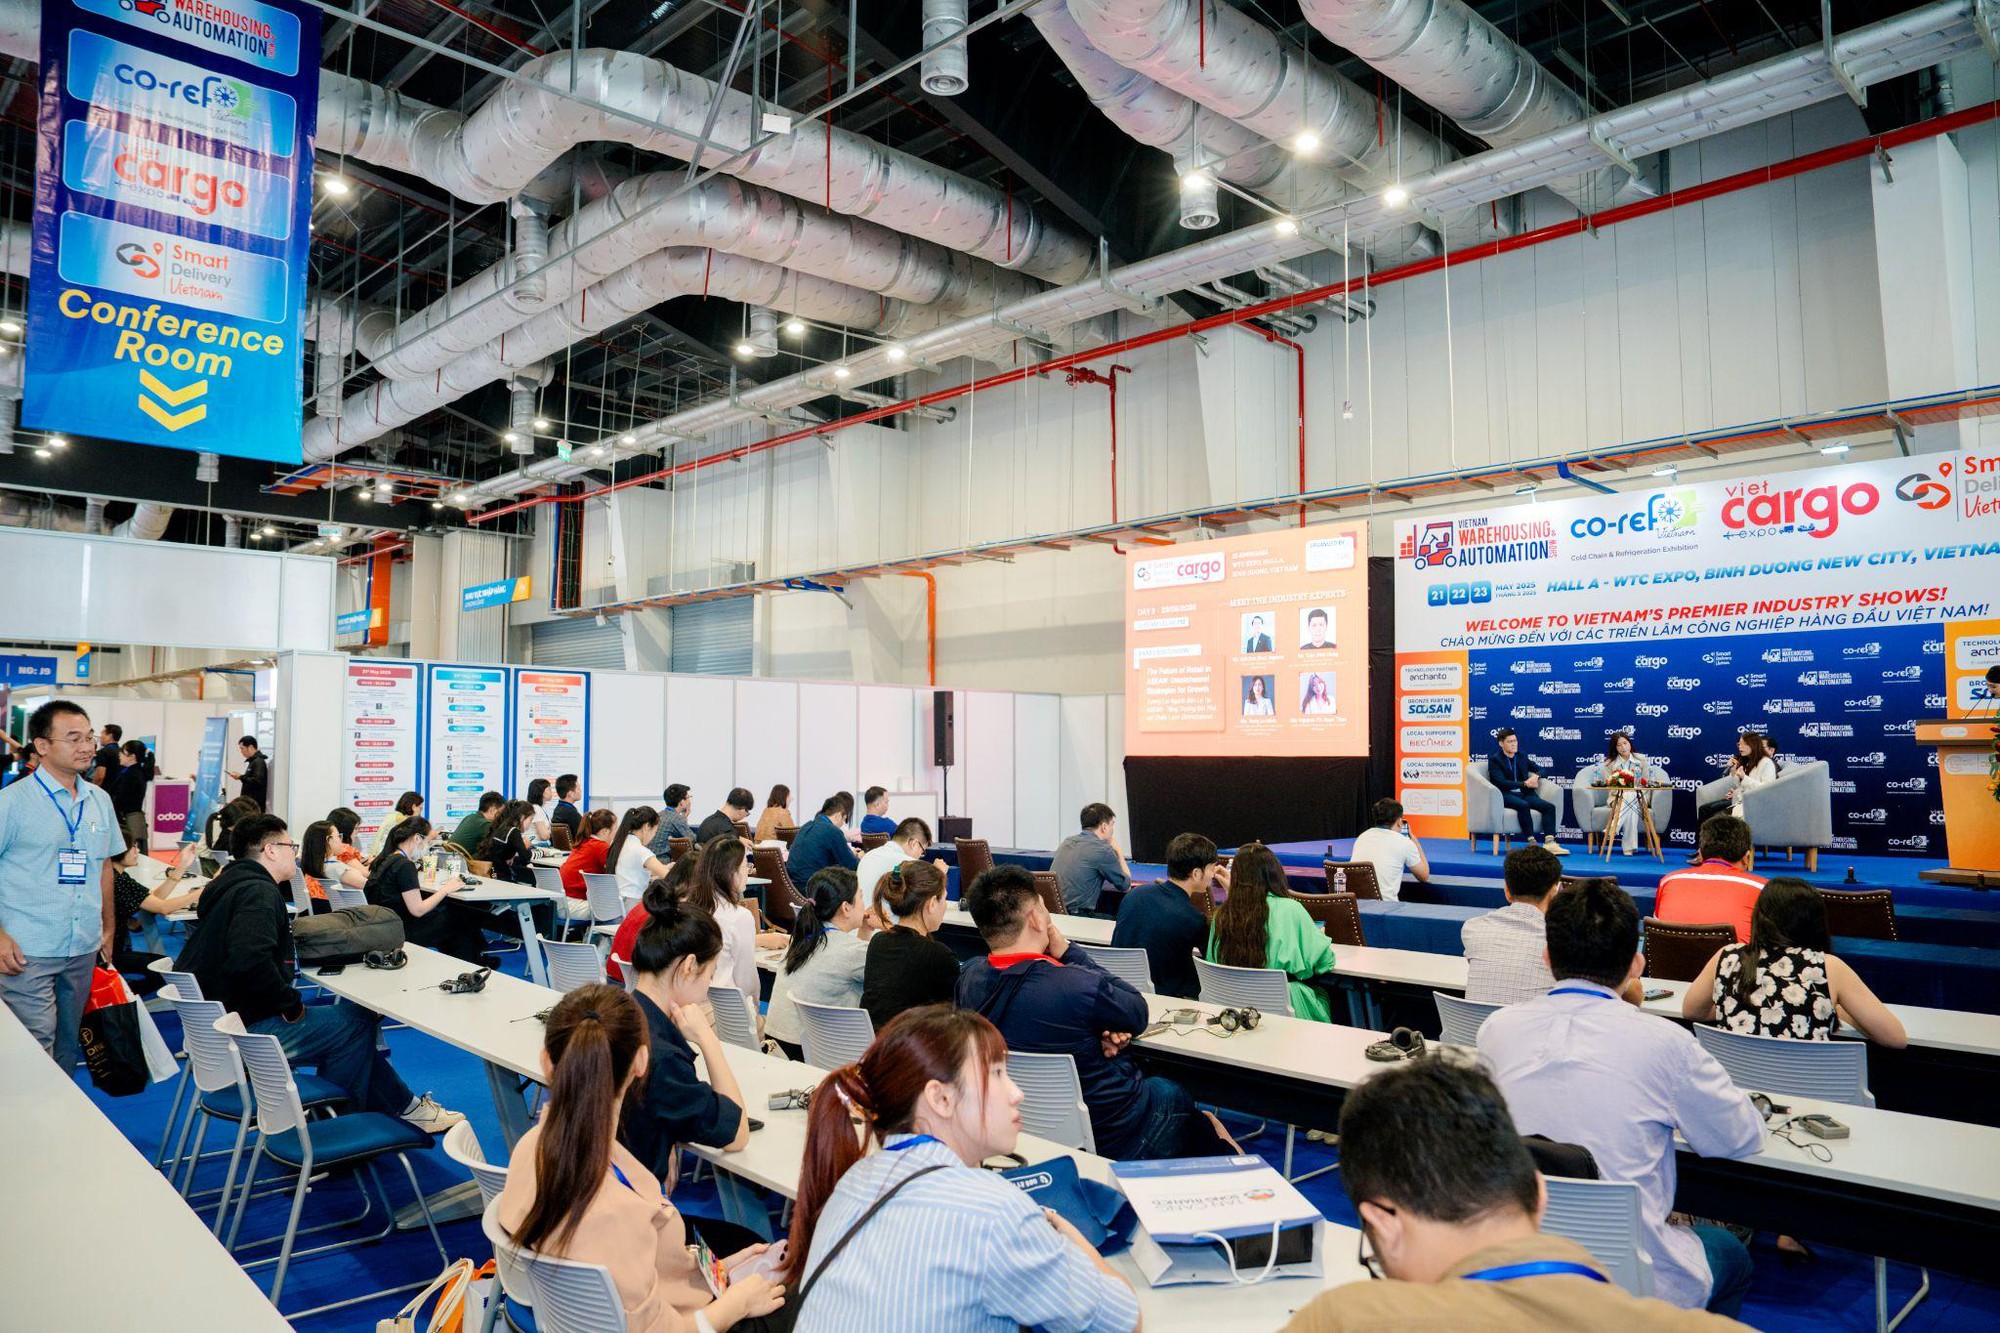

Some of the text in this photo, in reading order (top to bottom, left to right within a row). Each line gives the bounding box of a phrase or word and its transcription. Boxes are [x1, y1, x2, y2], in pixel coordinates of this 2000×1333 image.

[173, 12, 267, 57] AUTOMATION
[114, 153, 248, 215] cargo
[173, 244, 229, 270] Smart
[171, 262, 231, 288] Delivery
[170, 277, 223, 301] Vietnam
[58, 289, 285, 356] Conference
[113, 331, 233, 378] Room
[1725, 480, 1769, 497] viet
[1721, 482, 1880, 539] cargo
[1965, 494, 2000, 518] Viet
[1458, 517, 1488, 528] VIETNAM
[1459, 520, 1551, 546] WAREHOUSING
[1739, 527, 1776, 539] expo
[1459, 540, 1549, 567] AUTOMATION
[1571, 553, 1587, 562] Cold
[1588, 552, 1608, 561] Chain
[1615, 547, 1661, 559] Refrigeration
[1662, 543, 1698, 553] Exhibition
[1177, 561, 1221, 580] cargo
[1547, 579, 1585, 593] HALL
[1587, 578, 1600, 590] A
[1613, 574, 1649, 588] WTC
[1652, 569, 1700, 584] EXPO,
[1704, 565, 1744, 580] BINH
[1750, 559, 1814, 577] DUONG
[1817, 554, 1864, 570] NEW
[1867, 549, 1917, 566] CITY,
[1431, 586, 1488, 600] 21 22 23
[1495, 581, 1536, 592] MAY 2025
[1466, 587, 1948, 632] WELCOME TO VIETNAM'S PREMIER INDUSTRY SHOWS!
[1440, 603, 1990, 647] CHÀO MỪNG ĐẾN VỚI CÁC TRIỂN LÃM CÔNG NGHIỆP HÀNG ĐẦU VIỆT NAM!
[1635, 657, 1668, 669] cargo
[1410, 673, 1447, 681] anchanto
[1667, 678, 1700, 691] cargo
[1408, 704, 1452, 714] SOOSAN
[1636, 705, 1669, 717] cargo
[1668, 727, 1701, 740] cargo
[1646, 756, 1670, 768] rgo
[1671, 779, 1703, 792] cargo
[157, 812, 185, 821] odoo
[1670, 831, 1696, 844] carg
